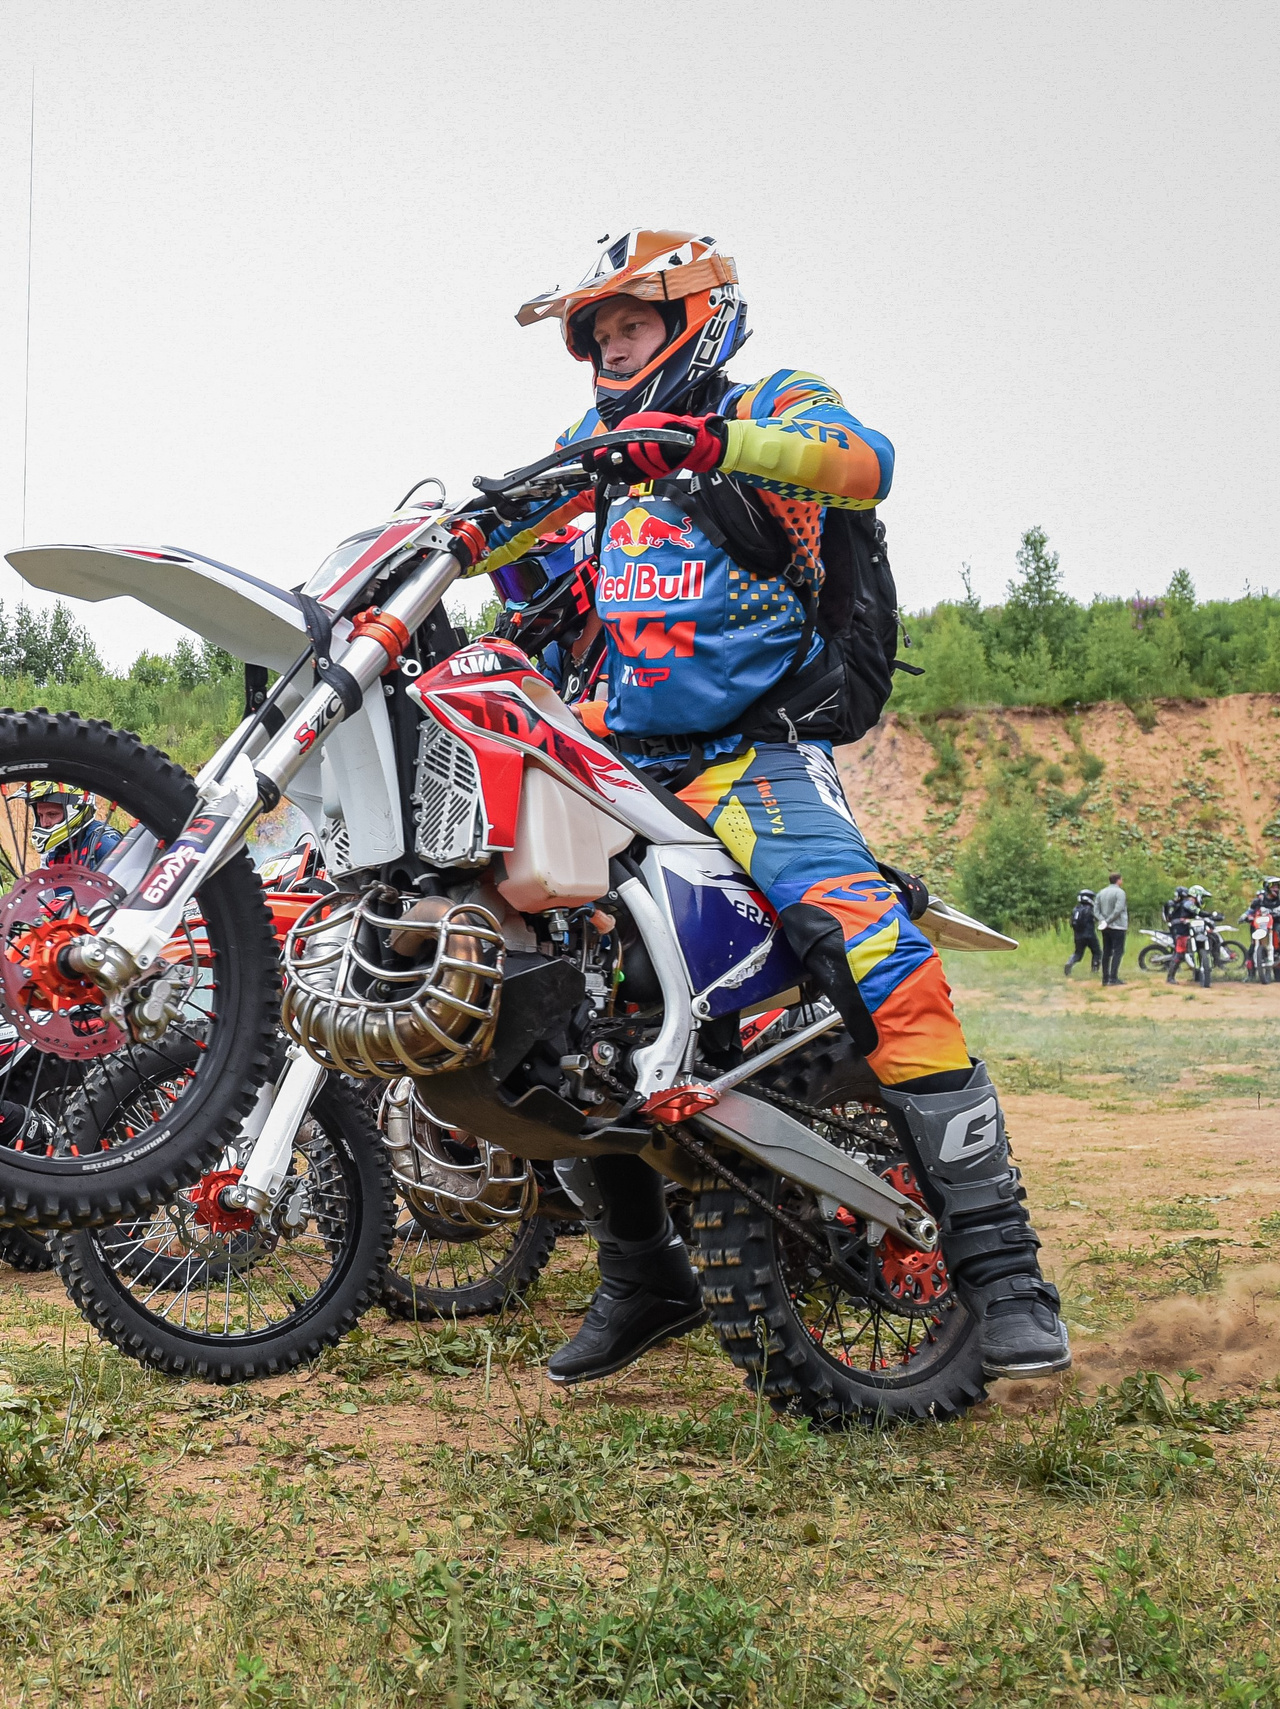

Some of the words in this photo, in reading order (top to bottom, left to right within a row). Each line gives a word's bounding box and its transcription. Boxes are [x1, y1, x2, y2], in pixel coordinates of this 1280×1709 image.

[632, 560, 706, 602] Bull
[448, 651, 501, 676] KTM
[142, 845, 196, 905] 6DAYS
